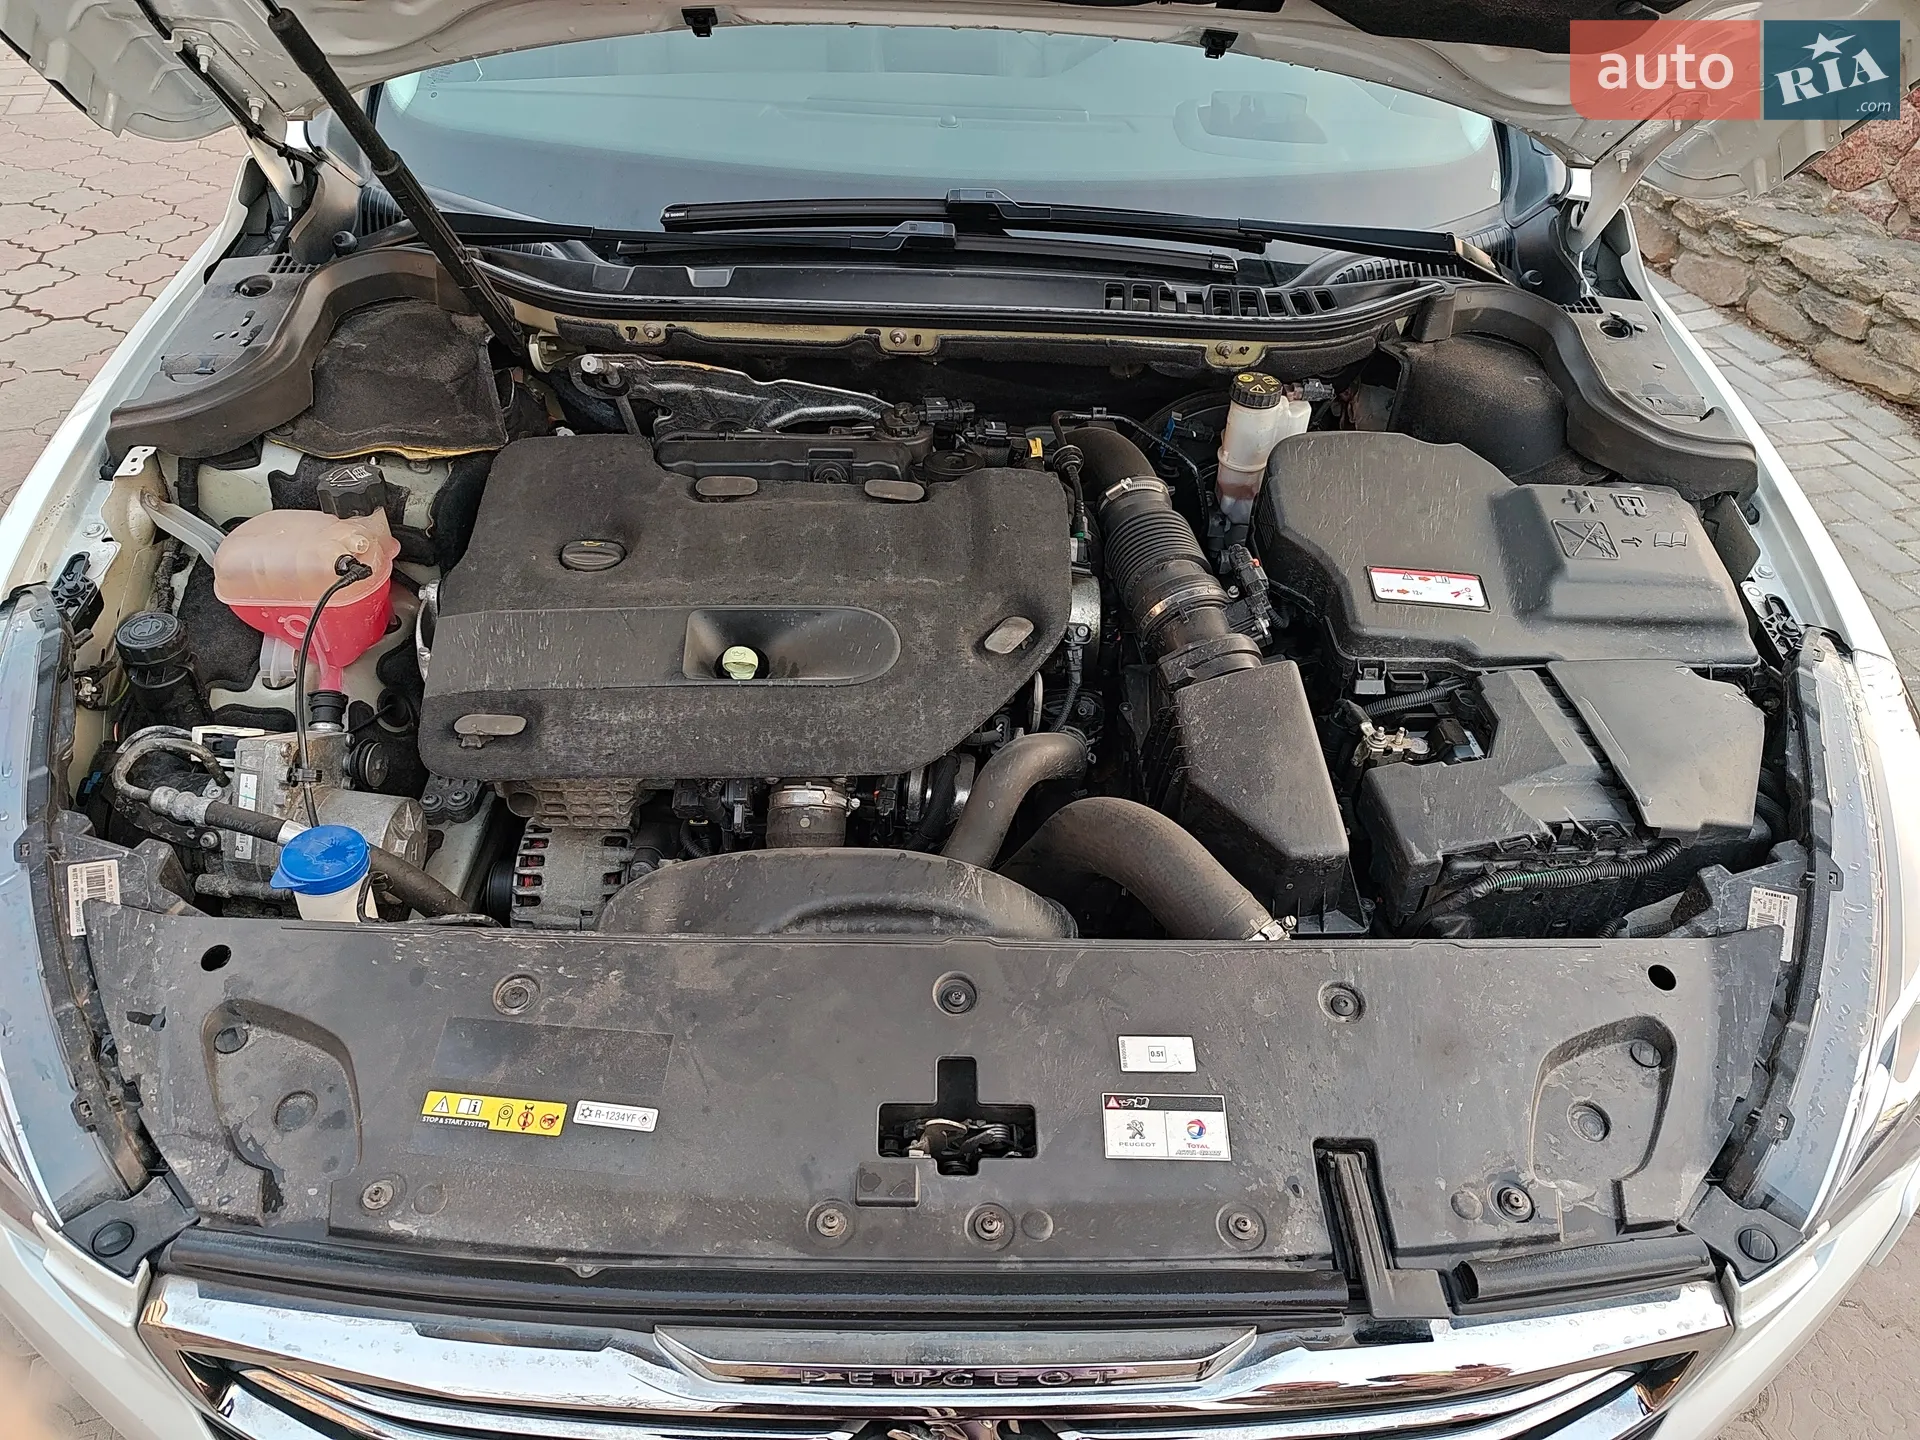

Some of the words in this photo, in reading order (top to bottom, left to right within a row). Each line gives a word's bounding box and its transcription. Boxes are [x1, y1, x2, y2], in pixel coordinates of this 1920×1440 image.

[444, 1118, 464, 1126] START
[463, 1120, 488, 1128] SYSTEM
[594, 1111, 637, 1123] R-1234YF
[800, 1369, 1116, 1387] PEUGEOT
